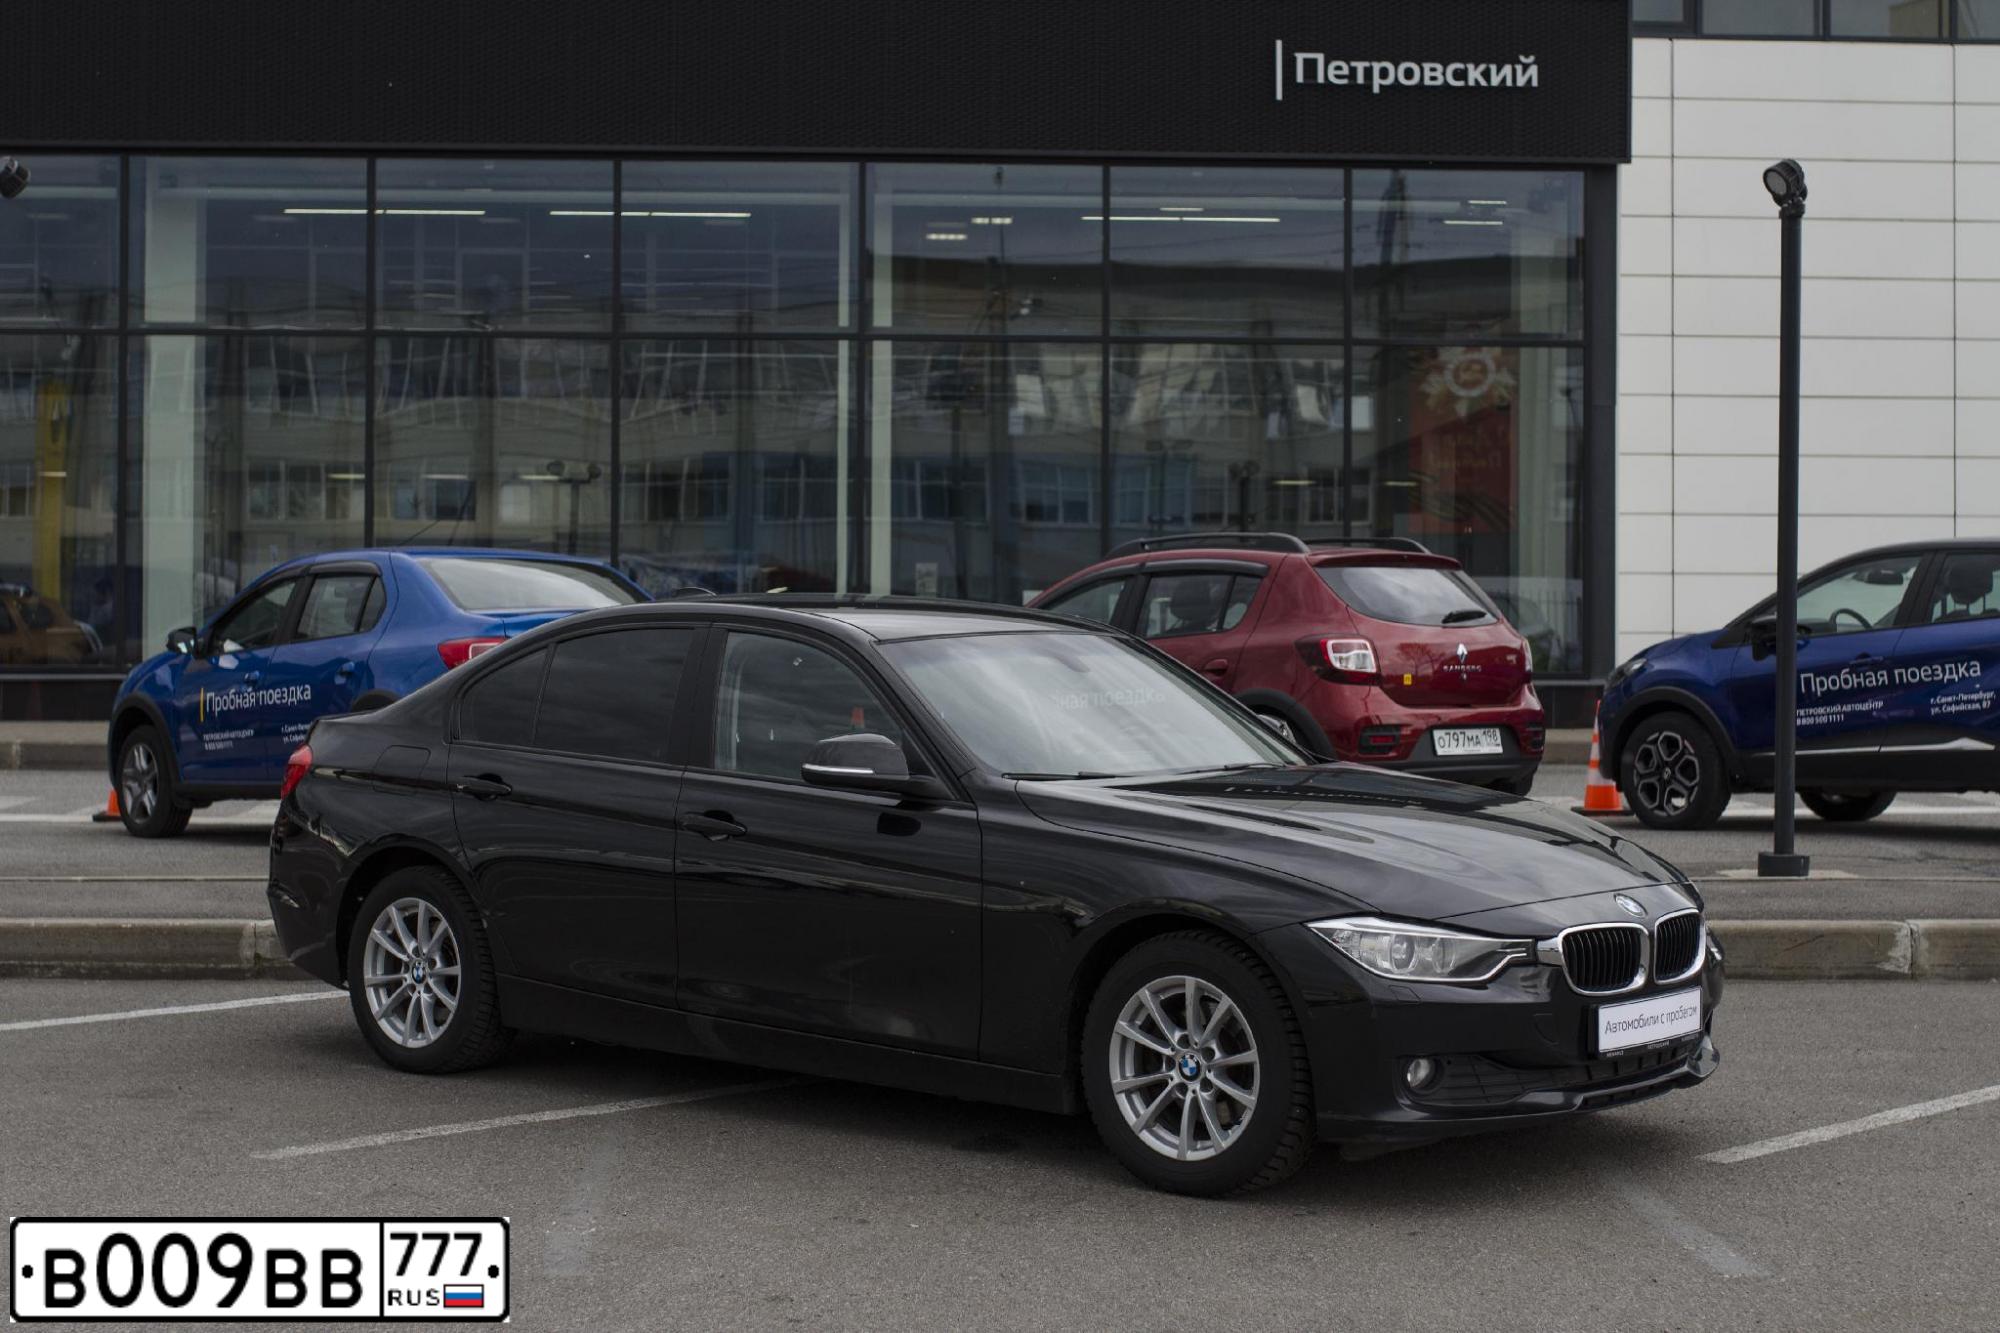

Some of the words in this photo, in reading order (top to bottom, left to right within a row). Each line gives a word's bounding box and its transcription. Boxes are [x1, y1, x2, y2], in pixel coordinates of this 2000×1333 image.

[1294, 52, 1539, 94] Петровский
[1800, 668, 1889, 697] Пробная
[1893, 660, 1982, 685] поездка
[206, 689, 256, 717] Пробная
[259, 683, 311, 707] поездка
[1604, 1013, 1659, 1035] Автомобили
[1660, 1013, 1665, 1024] с
[1666, 1005, 1698, 1025] пробегом
